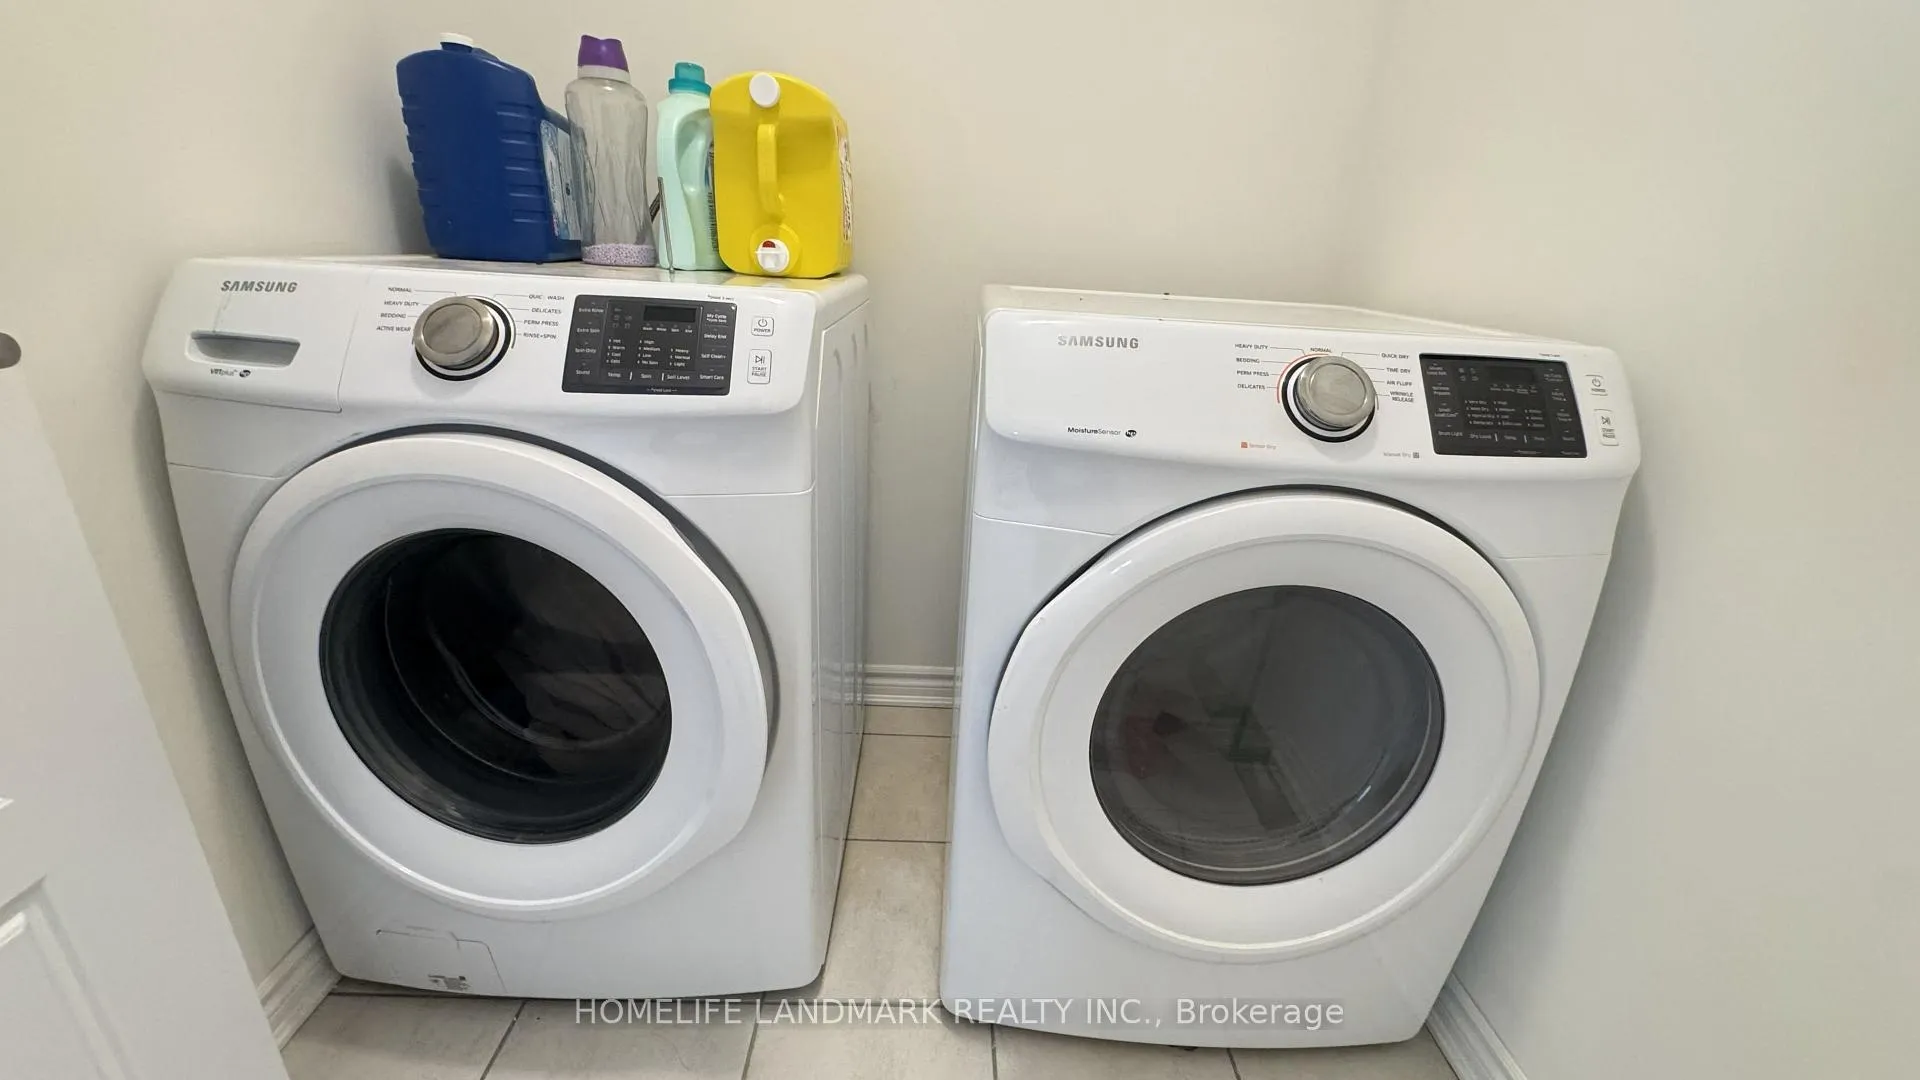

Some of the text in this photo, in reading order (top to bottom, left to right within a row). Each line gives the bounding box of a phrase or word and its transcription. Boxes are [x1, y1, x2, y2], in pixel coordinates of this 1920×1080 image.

[220, 280, 298, 293] SAMSUNG
[1057, 335, 1139, 349] SAMSUNG
[1067, 426, 1121, 436] MoistureSensor
